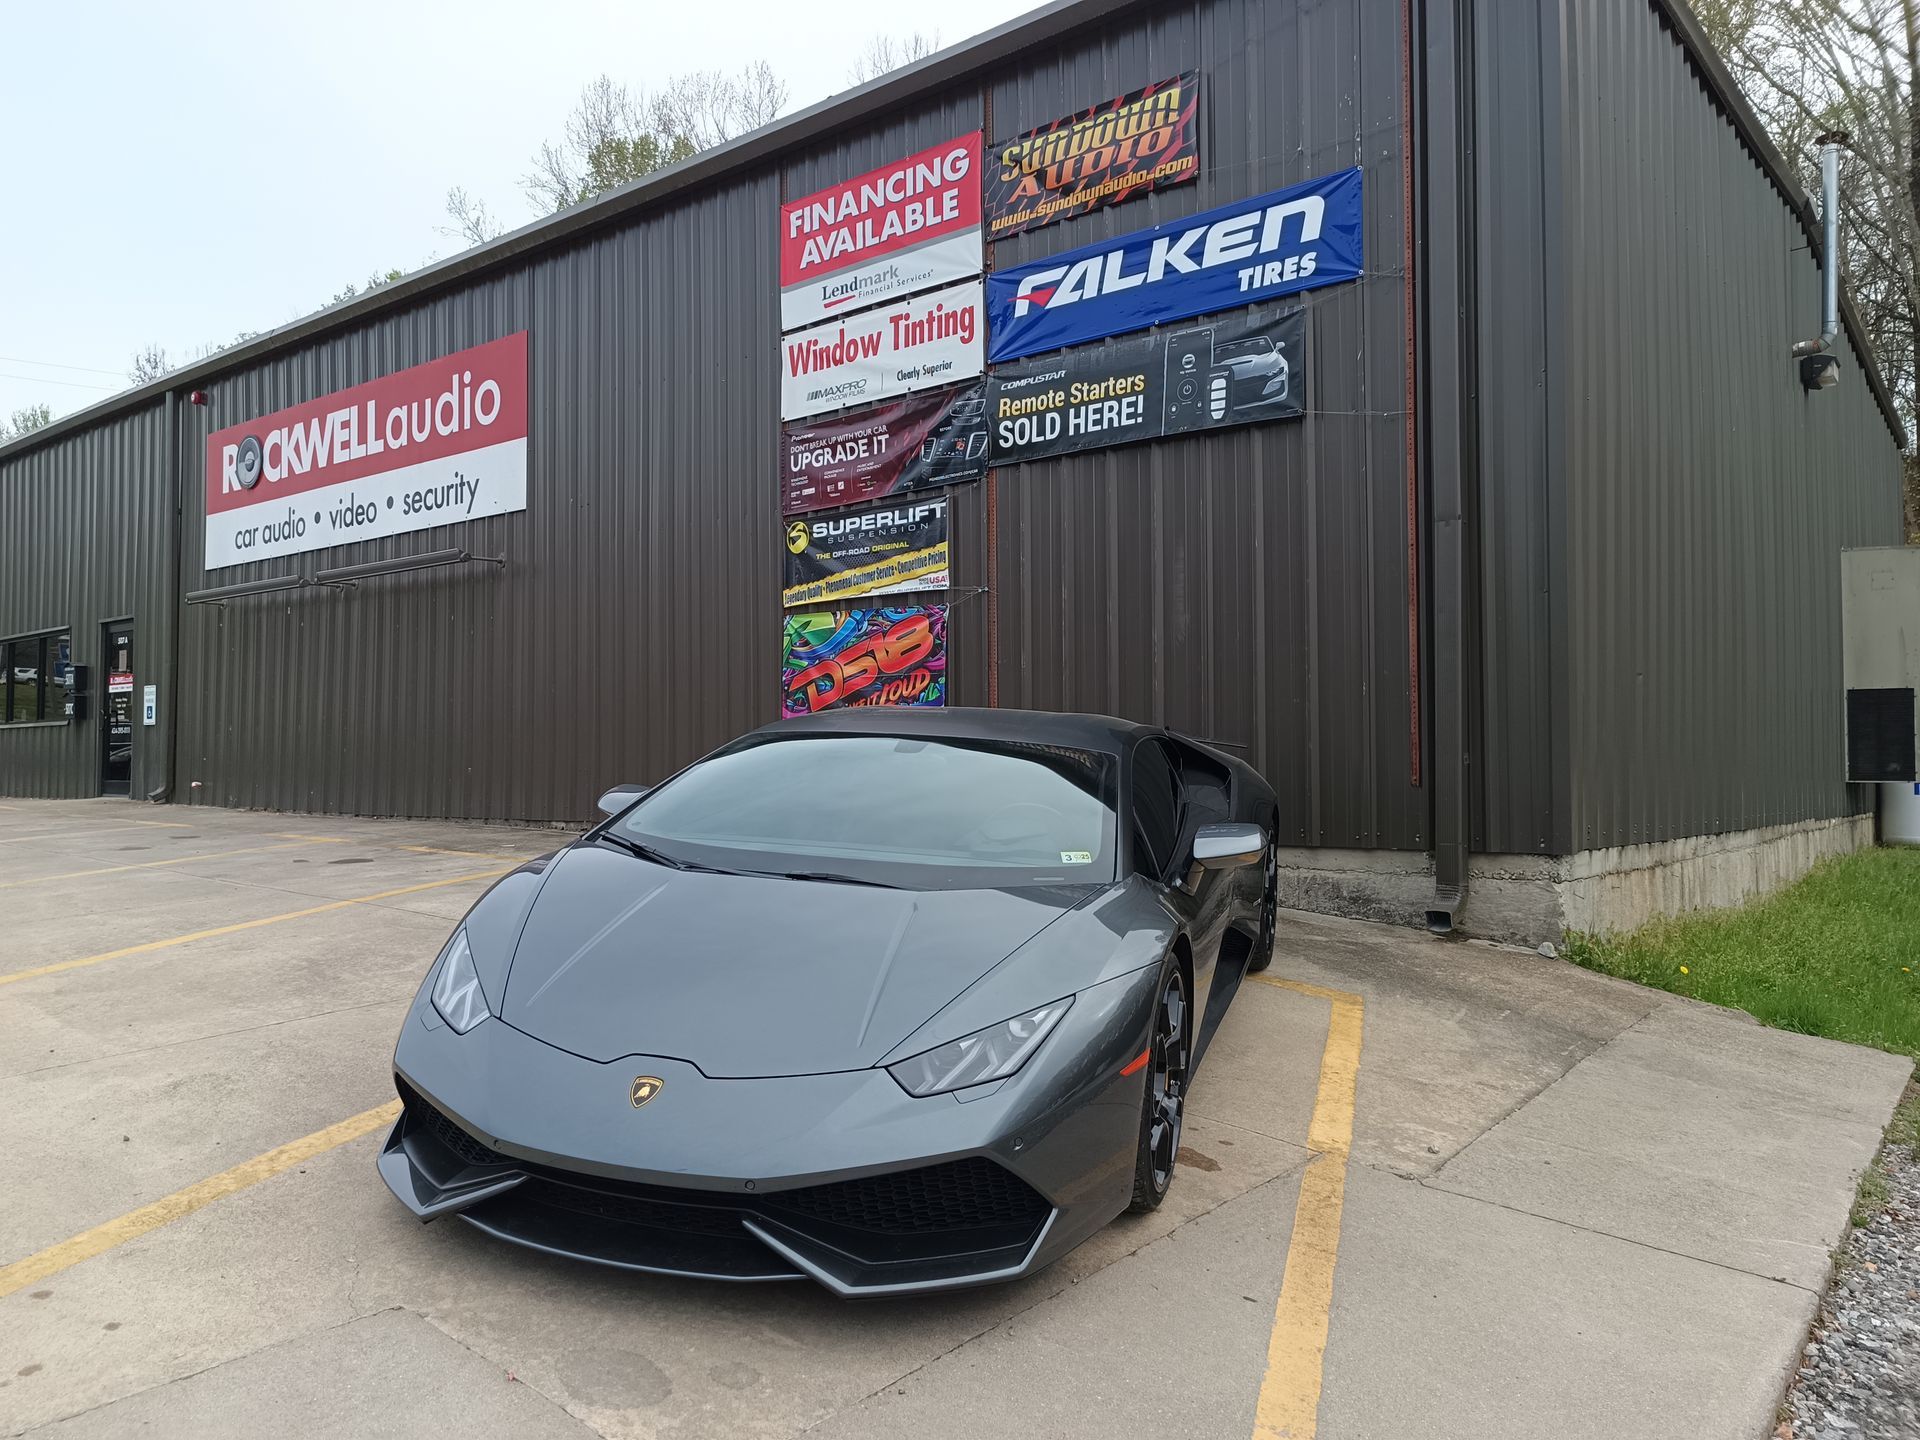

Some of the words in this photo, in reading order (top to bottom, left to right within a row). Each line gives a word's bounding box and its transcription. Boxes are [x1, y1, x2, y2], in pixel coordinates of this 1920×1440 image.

[789, 148, 970, 239] FINANCING
[991, 155, 1193, 232] www.sundownaudio.com
[800, 188, 960, 270] AVAILABLE
[1011, 195, 1325, 319] FALKEN
[1238, 251, 1317, 292] TIRES
[821, 264, 900, 301] Lendmark
[858, 281, 894, 299] Financial
[896, 270, 932, 288] Services
[788, 328, 882, 378] Window
[889, 303, 975, 352] Tinting
[896, 367, 921, 383] Clearly
[922, 360, 953, 377] Superior
[1001, 369, 1068, 391] COMPUSTAR
[825, 393, 848, 403] WINDOW
[998, 387, 1065, 418] Remote
[1070, 373, 1145, 404] Starters
[790, 443, 809, 454] DON'T
[809, 438, 828, 450] BREAK
[828, 436, 837, 445] UP
[836, 432, 854, 443] WITH
[854, 428, 872, 438] YOUR
[873, 424, 888, 434] CAR
[998, 407, 1061, 449] SOLD
[1068, 395, 1144, 437] HERE!
[790, 439, 870, 472] UPGRADE
[873, 434, 890, 455] IT
[235, 526, 259, 550] car
[262, 507, 306, 544] audio
[329, 492, 377, 531] video
[403, 471, 479, 515] security
[812, 502, 947, 538] SUPERLIFT
[815, 552, 831, 560] THE
[832, 546, 870, 558] OFF-ROAD
[871, 541, 910, 552] ORIGINAL
[827, 522, 929, 544] SUSPENSION
[929, 575, 946, 585] USA
